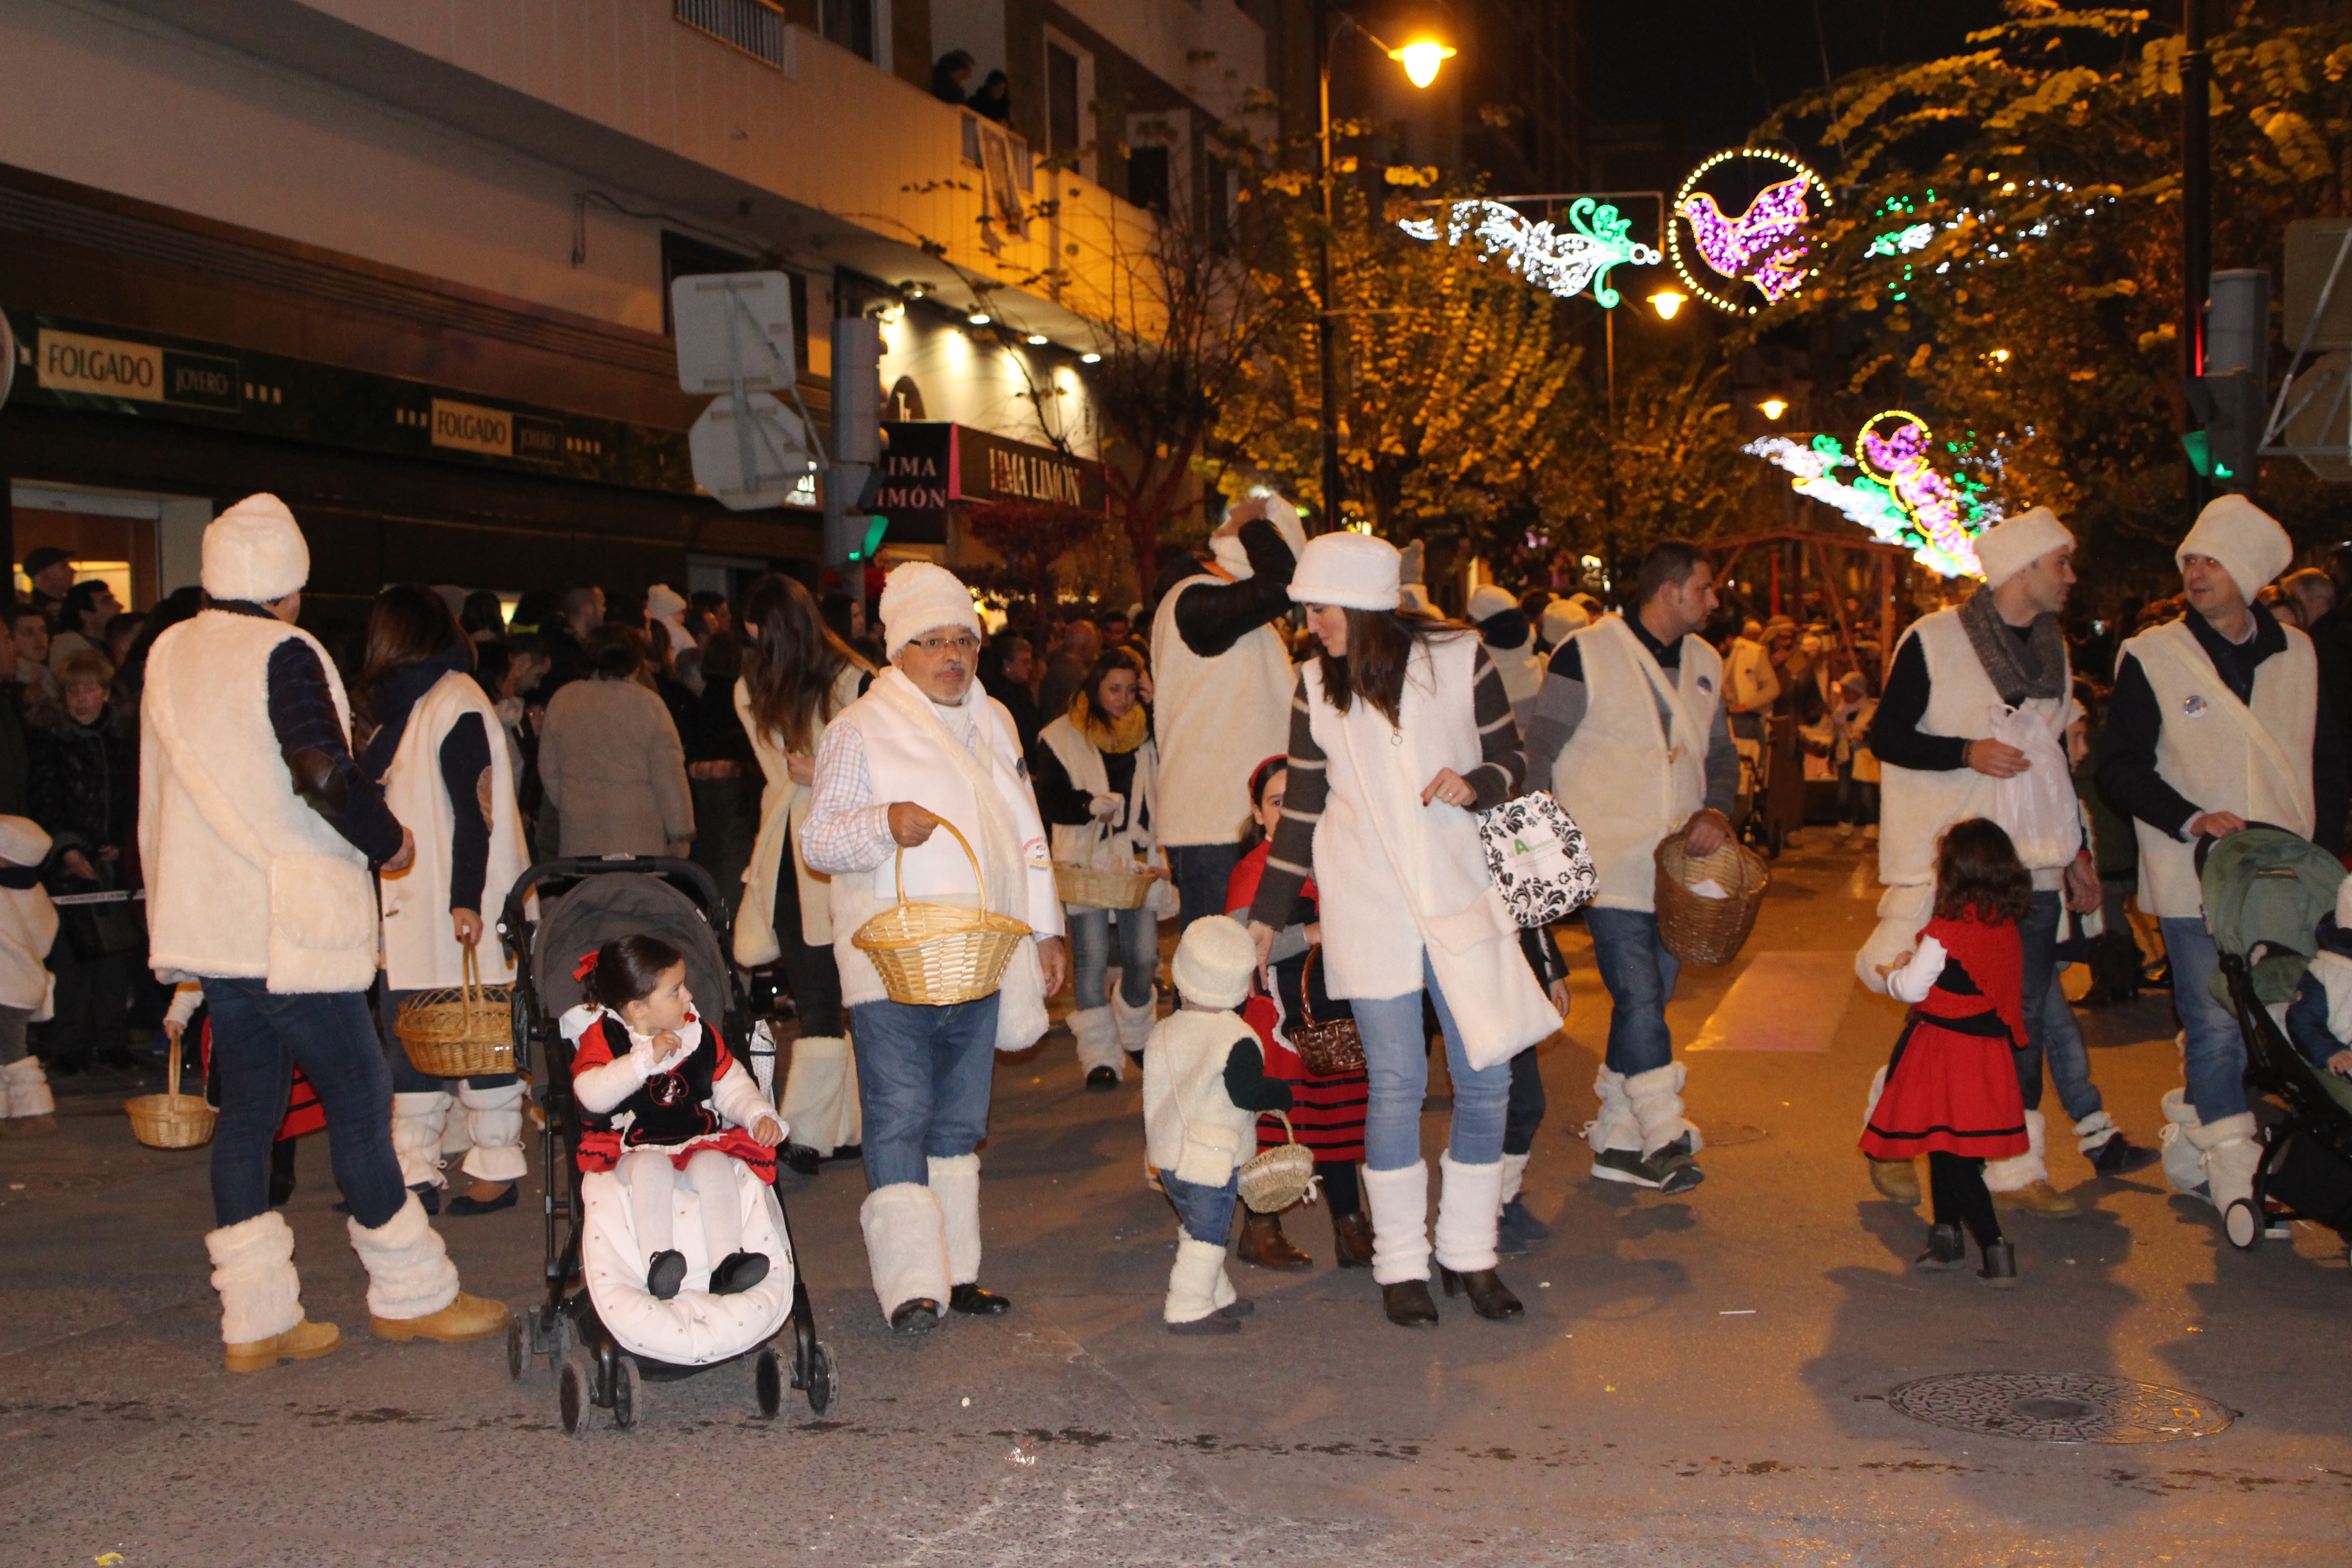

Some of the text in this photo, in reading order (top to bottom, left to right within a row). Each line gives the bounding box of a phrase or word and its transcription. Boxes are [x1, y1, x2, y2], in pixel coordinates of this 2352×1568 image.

[48, 343, 228, 396] FOLGADO JOYERO
[437, 410, 507, 445] FOLGADO
[888, 456, 936, 476] IMA
[876, 483, 946, 509] IMÓN
